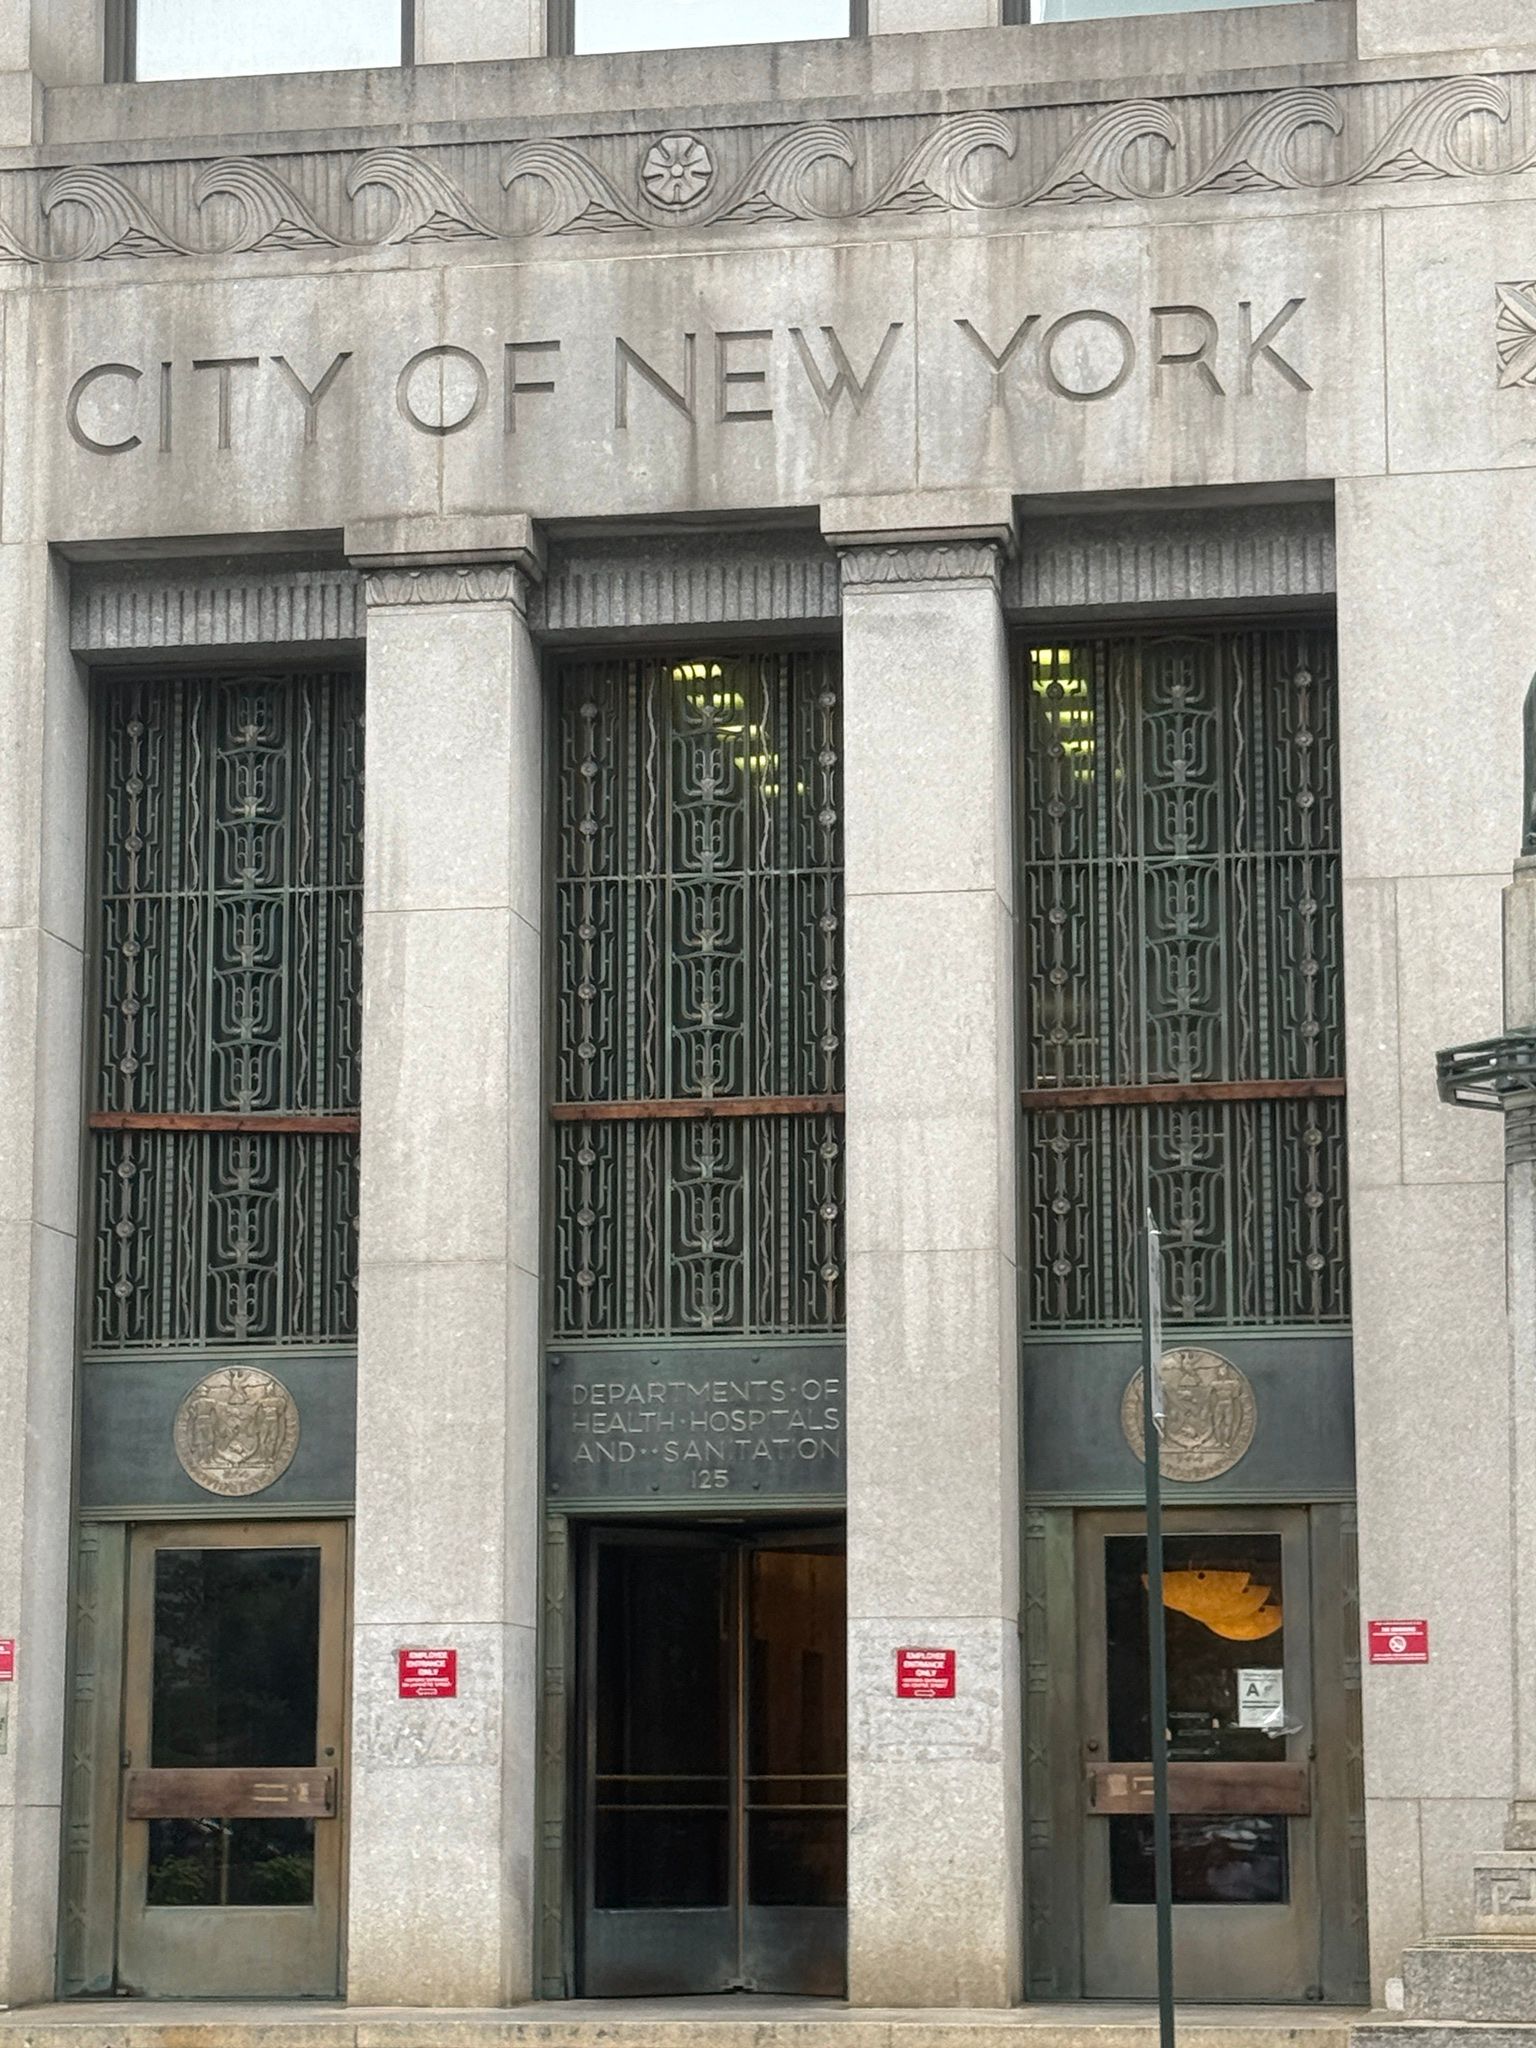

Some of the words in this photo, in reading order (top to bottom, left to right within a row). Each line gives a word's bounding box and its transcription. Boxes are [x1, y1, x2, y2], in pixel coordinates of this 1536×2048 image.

[66, 350, 354, 457] CITY
[396, 340, 562, 437] OF
[614, 321, 906, 430] NEW
[953, 297, 1313, 403] YORK
[572, 1379, 785, 1405] DEPARTMENTS
[801, 1378, 840, 1402] OF
[572, 1411, 675, 1434] HEALTH
[690, 1407, 841, 1433] HOSPTALS
[574, 1440, 635, 1464] AND
[691, 1469, 730, 1490] 125
[1246, 1682, 1260, 1697] A
